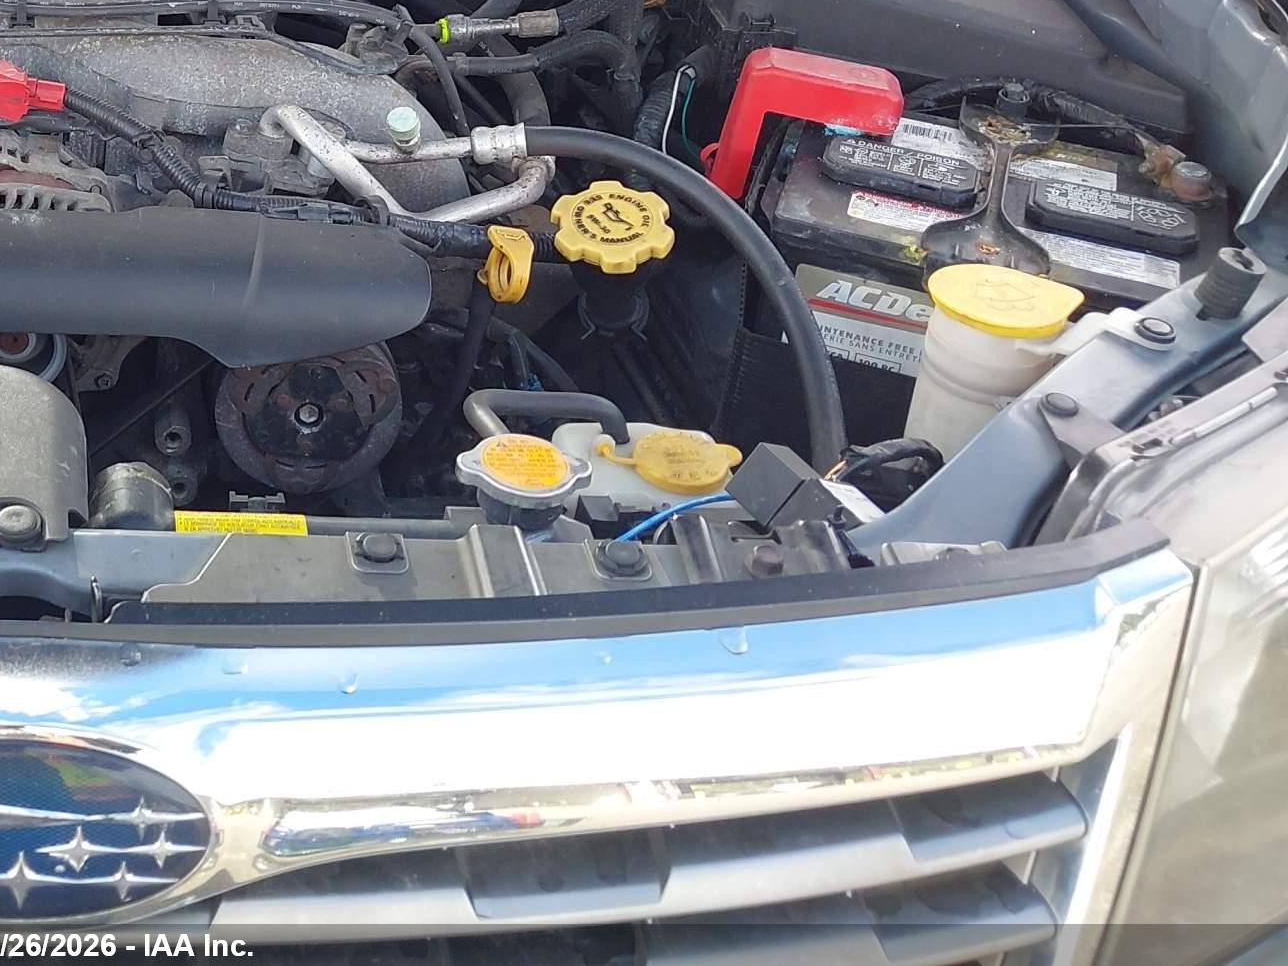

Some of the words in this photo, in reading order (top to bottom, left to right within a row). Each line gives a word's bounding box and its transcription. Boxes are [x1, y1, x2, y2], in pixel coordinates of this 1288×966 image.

[857, 140, 905, 154] DANGER
[916, 152, 961, 166] POISON
[609, 194, 647, 212] ENGINE
[642, 215, 650, 227] OIL
[600, 232, 643, 243] MANUAL
[849, 339, 874, 352] SANS
[887, 342, 915, 355] FREE
